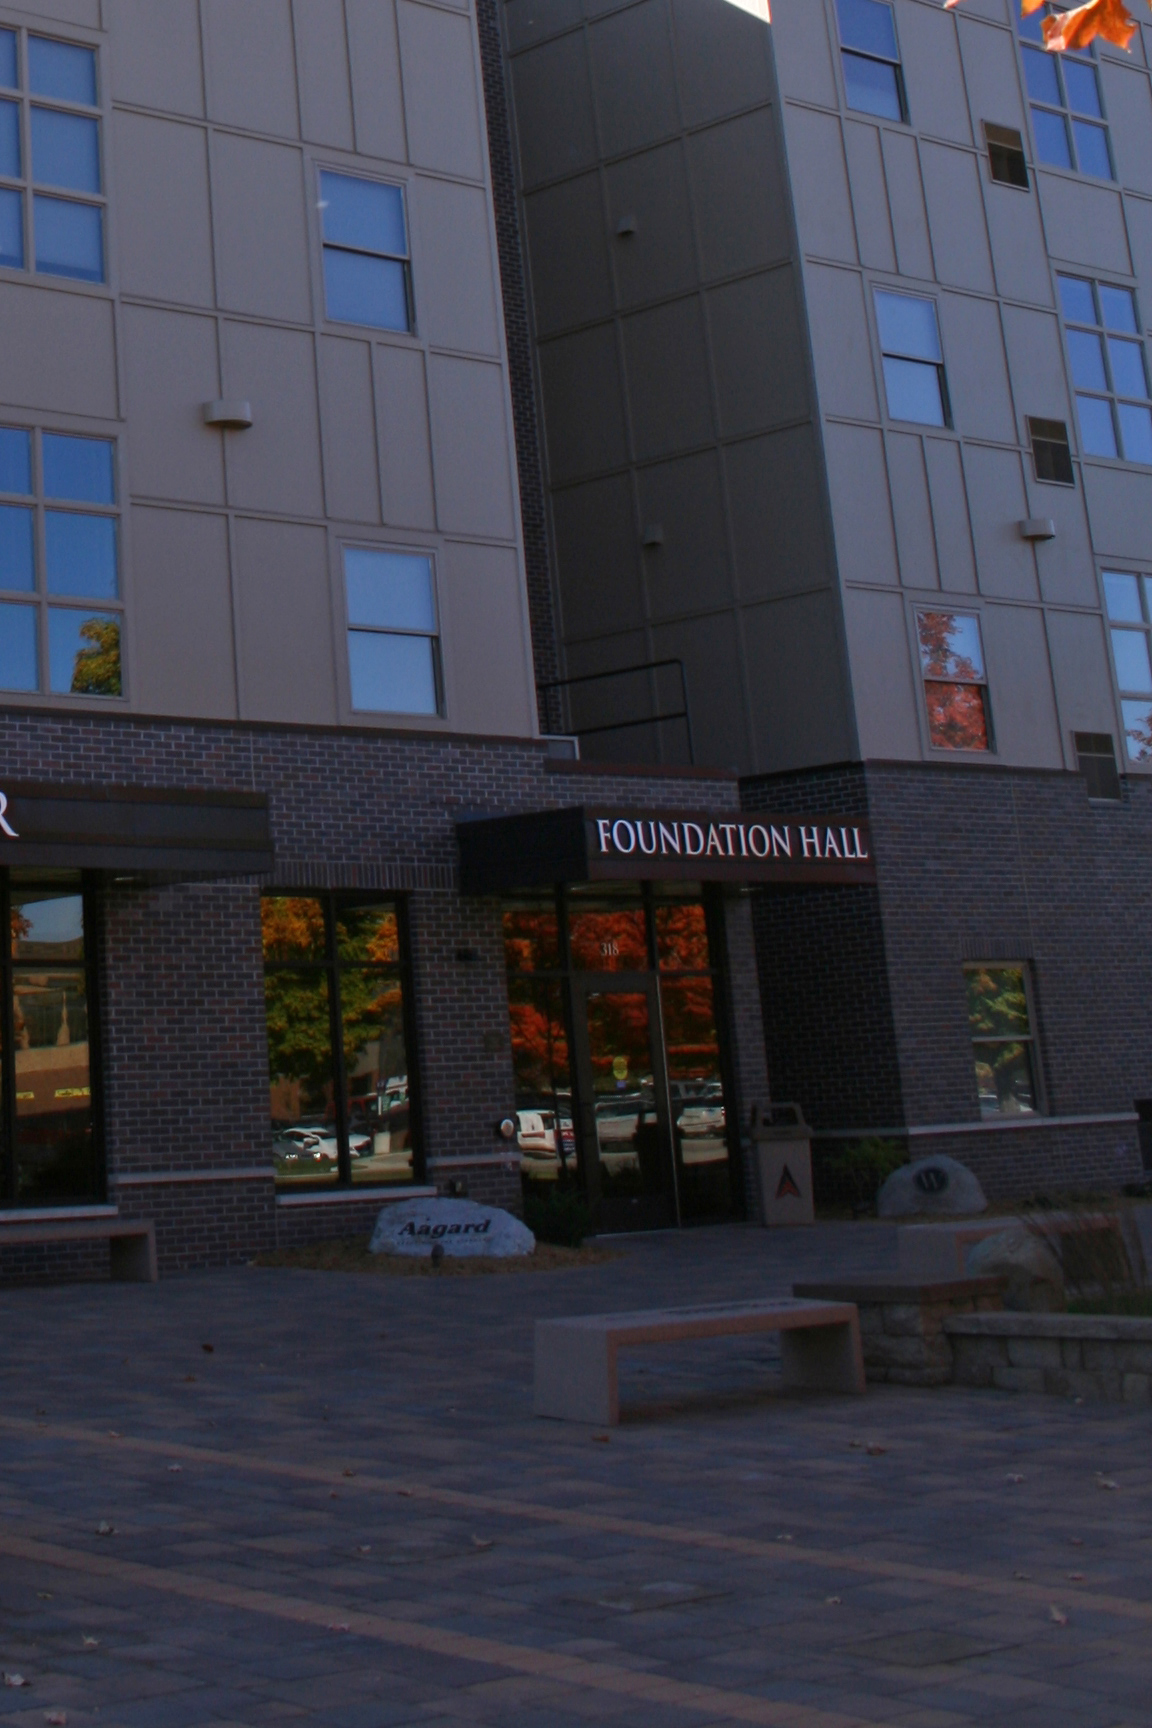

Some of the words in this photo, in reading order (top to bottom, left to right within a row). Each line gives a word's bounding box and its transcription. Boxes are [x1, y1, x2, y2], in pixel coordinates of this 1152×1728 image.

[596, 818, 792, 858] FOUNDATION
[798, 825, 869, 860] HALL
[600, 939, 619, 956] 318
